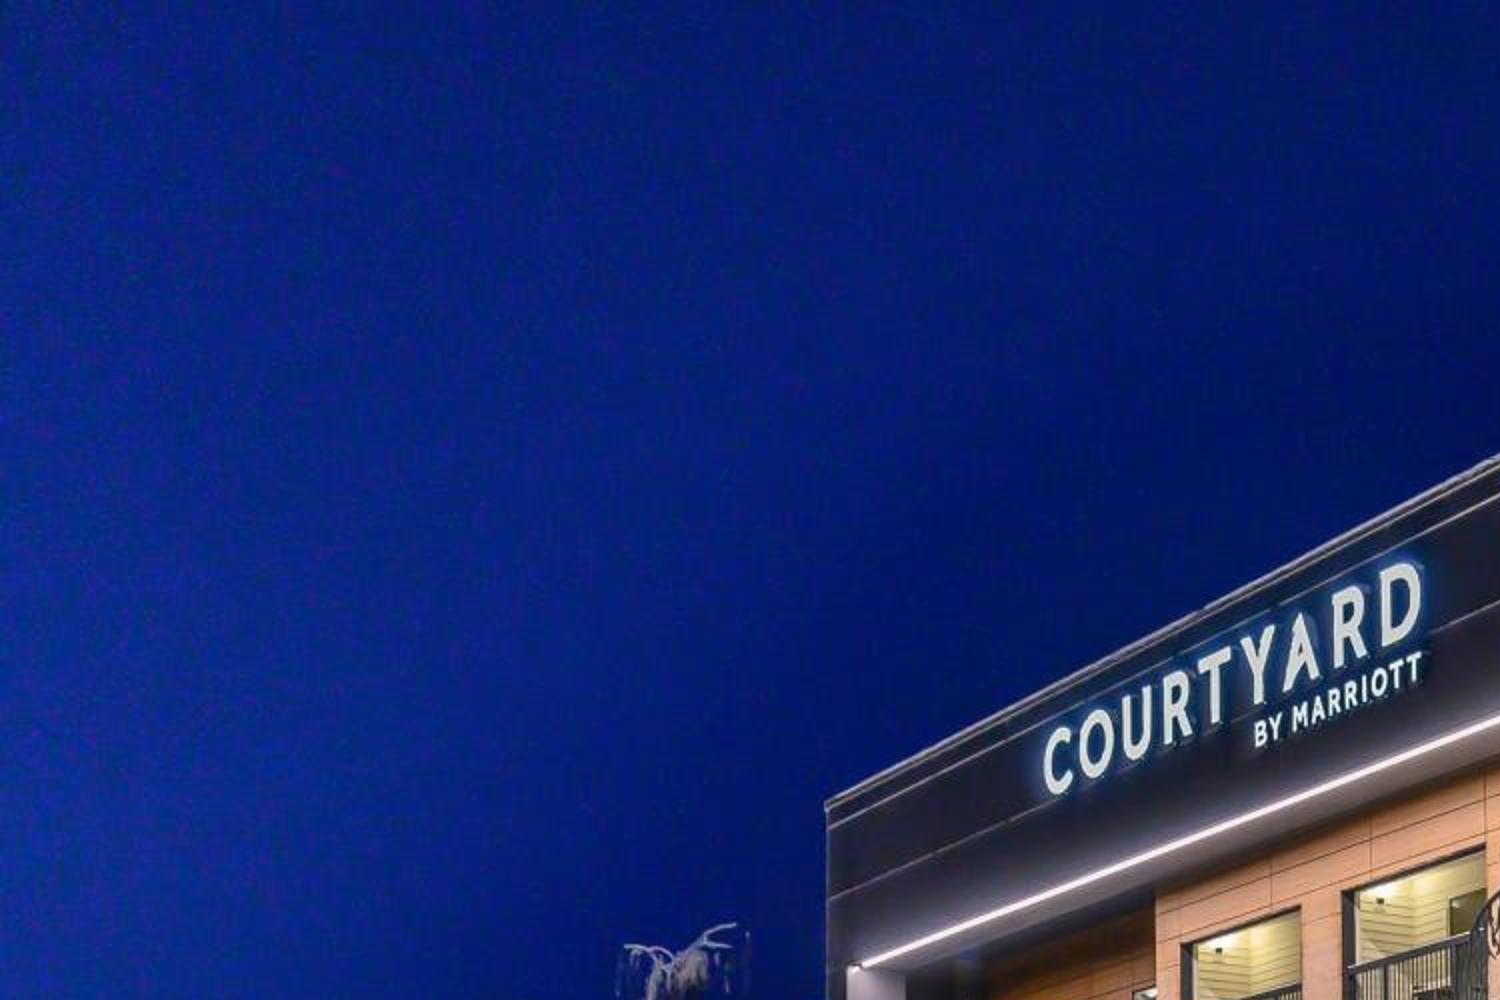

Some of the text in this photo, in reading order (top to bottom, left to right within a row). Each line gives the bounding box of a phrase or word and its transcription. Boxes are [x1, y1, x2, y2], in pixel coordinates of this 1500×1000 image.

[1043, 562, 1422, 796] COURTYARD
[1254, 651, 1423, 748] BY MARRIOTT
